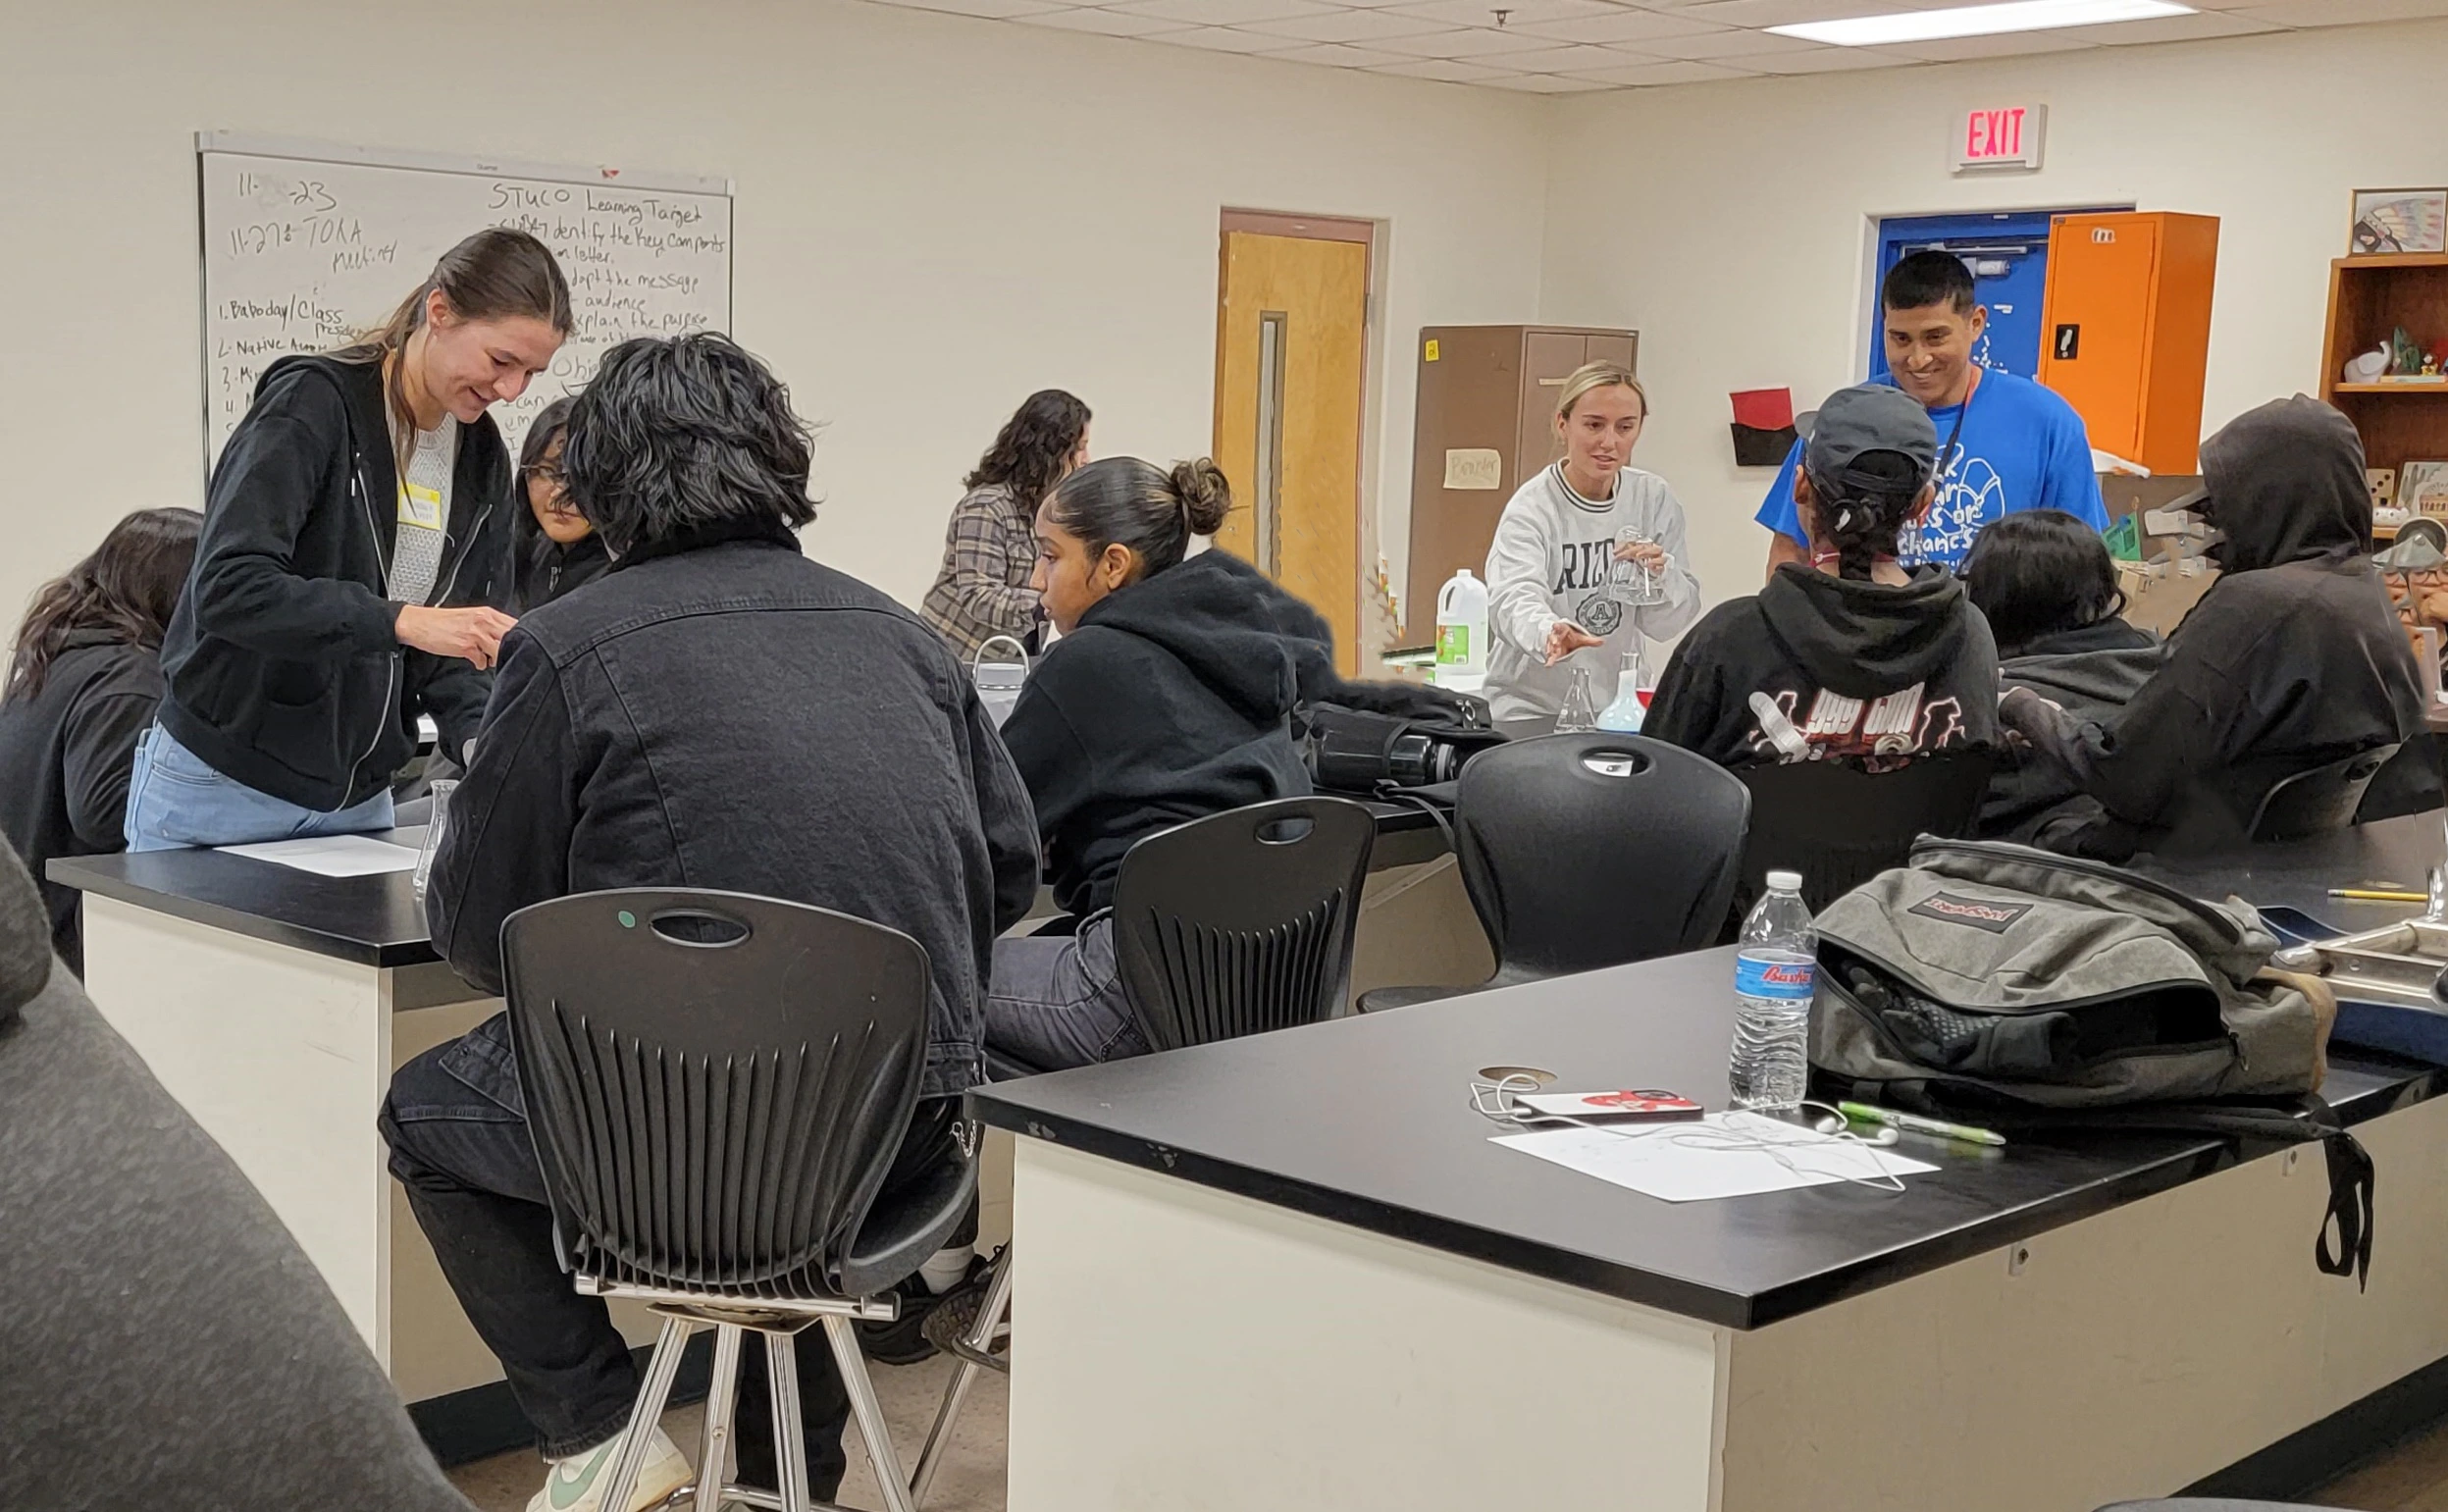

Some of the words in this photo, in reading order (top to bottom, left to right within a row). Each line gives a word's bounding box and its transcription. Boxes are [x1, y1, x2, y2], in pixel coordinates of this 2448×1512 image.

[1967, 108, 2026, 157] EXIT
[586, 188, 644, 226] Learning
[643, 199, 703, 228] Target
[609, 223, 633, 245] the
[605, 269, 632, 286] the
[631, 311, 659, 329] the
